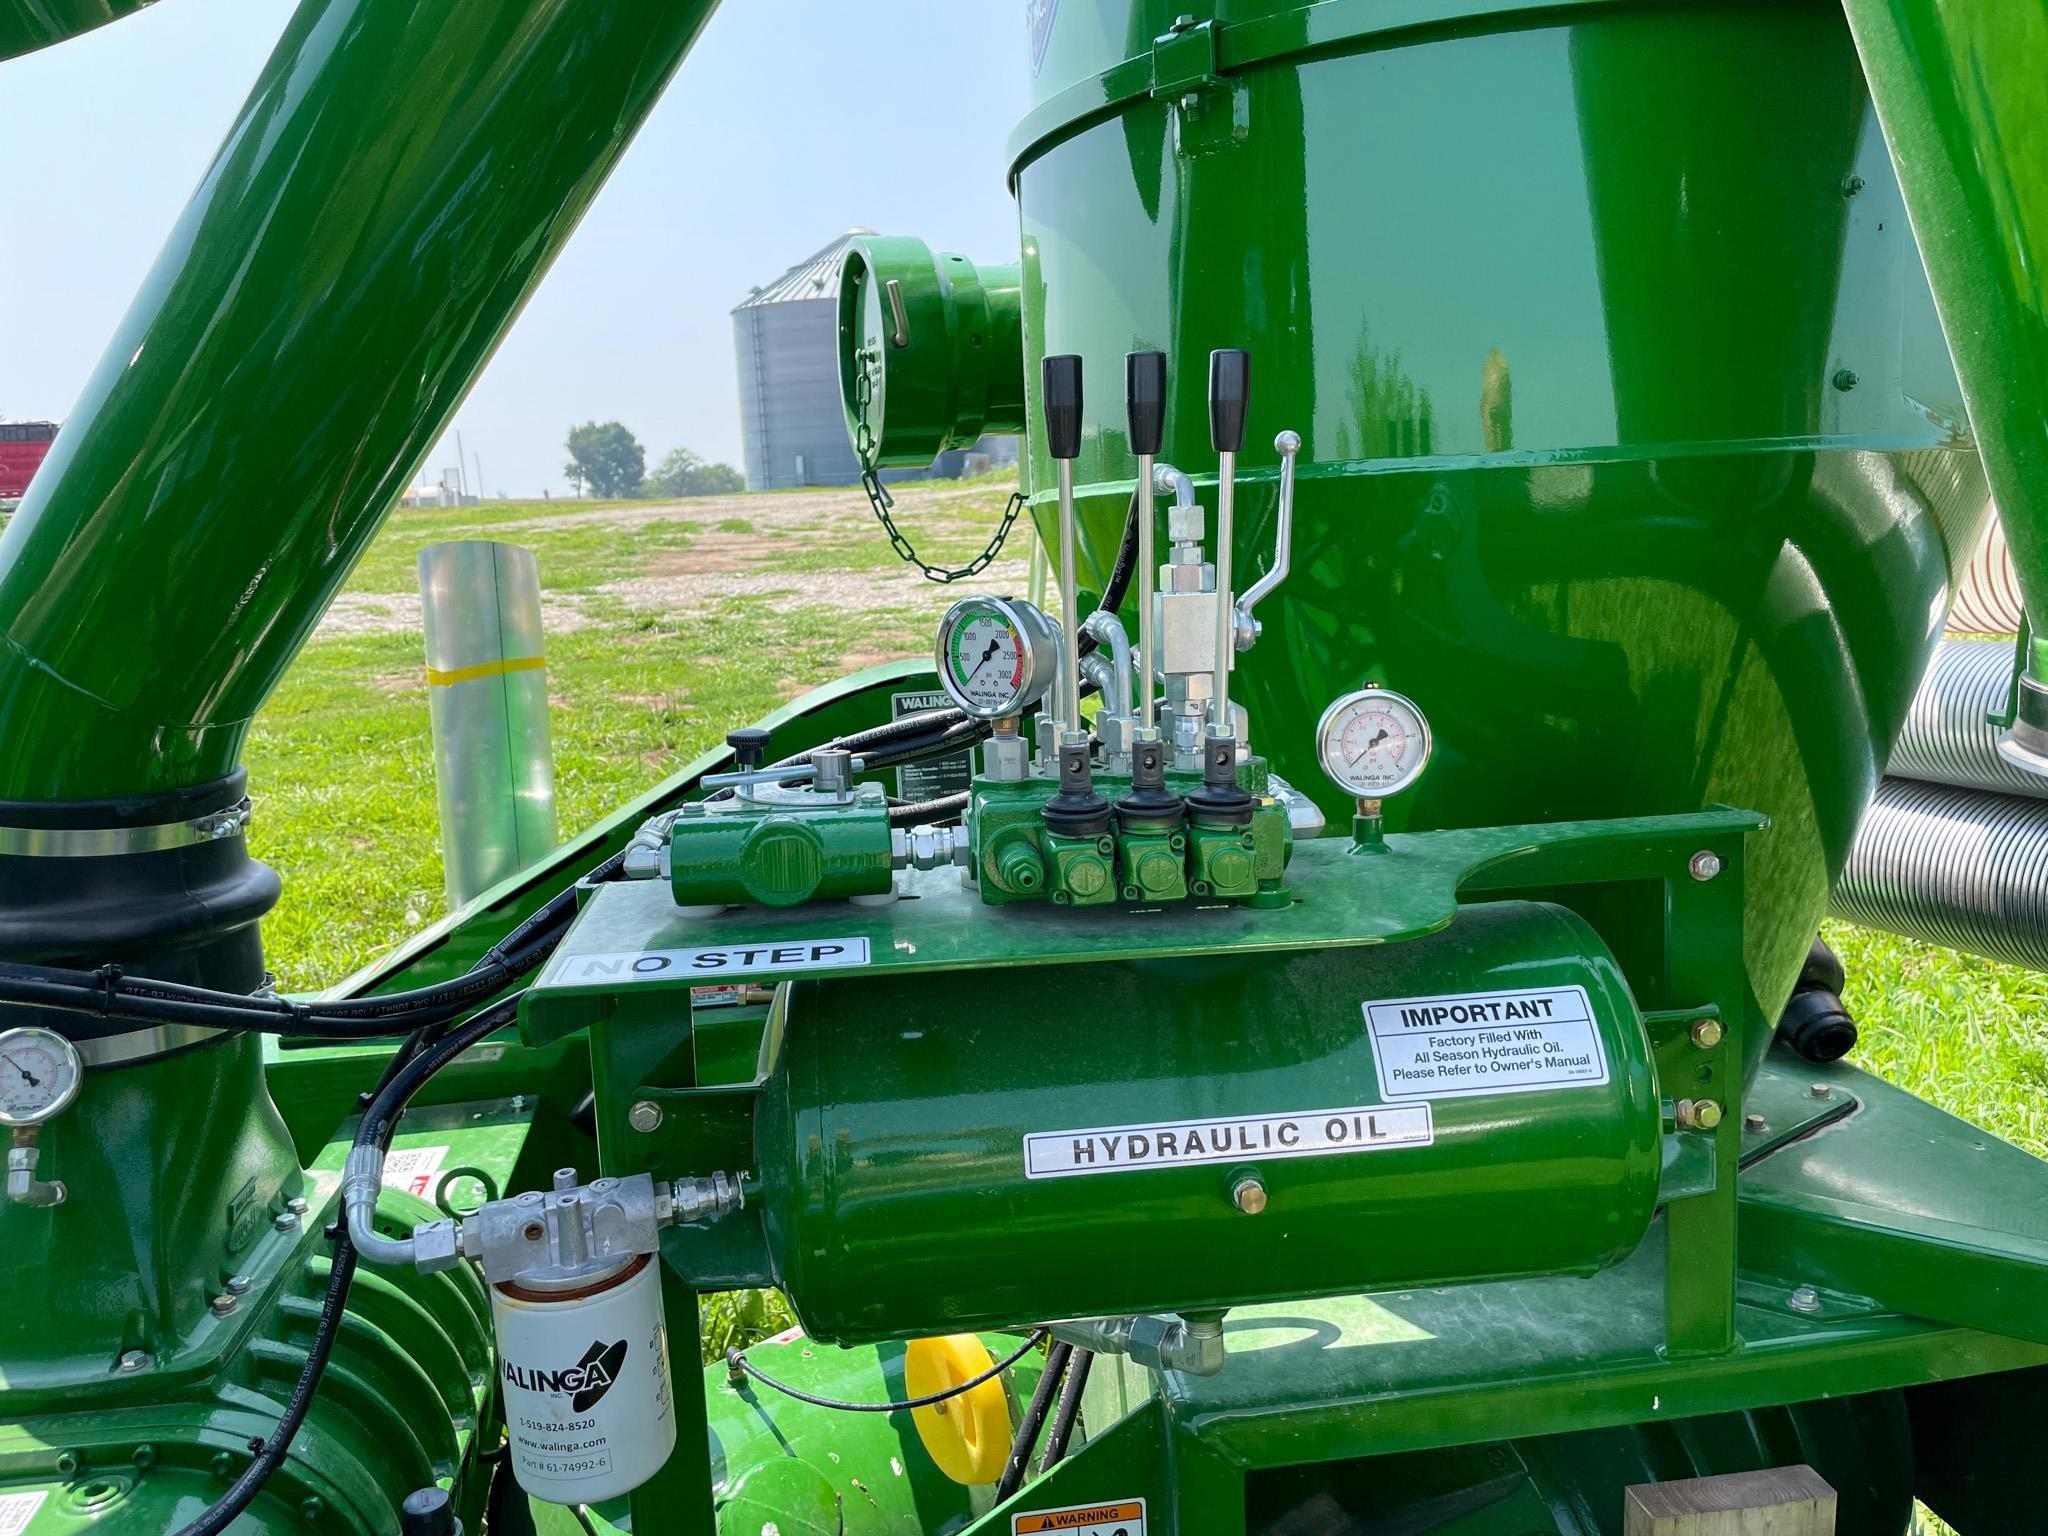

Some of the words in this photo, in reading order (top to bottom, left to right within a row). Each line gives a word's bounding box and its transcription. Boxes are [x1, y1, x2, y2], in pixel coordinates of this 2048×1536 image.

[980, 618, 992, 628] 1500
[964, 632, 976, 640] 1000
[996, 630, 1010, 640] 2000
[960, 652, 970, 661] 500
[1002, 651, 1018, 660] 2500
[998, 670, 1012, 679] 3000
[970, 690, 997, 698] WALINGA
[902, 696, 955, 710] WALING
[582, 956, 672, 977] NO
[691, 945, 845, 968] STEP
[1400, 998, 1554, 1028] IMPORTANT
[1428, 1034, 1476, 1048] Factory
[1478, 1032, 1512, 1044] Filled
[1514, 1028, 1542, 1041] With
[1414, 1051, 1430, 1064] All
[1433, 1048, 1480, 1062] Season
[1482, 1044, 1540, 1060] Hydraulic
[1543, 1042, 1564, 1054] Oil.
[1393, 1066, 1435, 1080] Please
[1438, 1065, 1472, 1078] Refer
[1474, 1064, 1488, 1075] to
[1490, 1058, 1542, 1073] Owner's
[1545, 1054, 1591, 1068] Manual
[1074, 1122, 1300, 1164] HYDRAULIC
[1325, 1114, 1387, 1142] OIL
[520, 1418, 596, 1432] 1-519-824-8520
[518, 1436, 606, 1452] www.walinga.com
[522, 1456, 537, 1469] Part
[539, 1462, 544, 1470] #
[546, 1458, 606, 1472] 61-74992-6
[1056, 1508, 1118, 1526] WARNING
